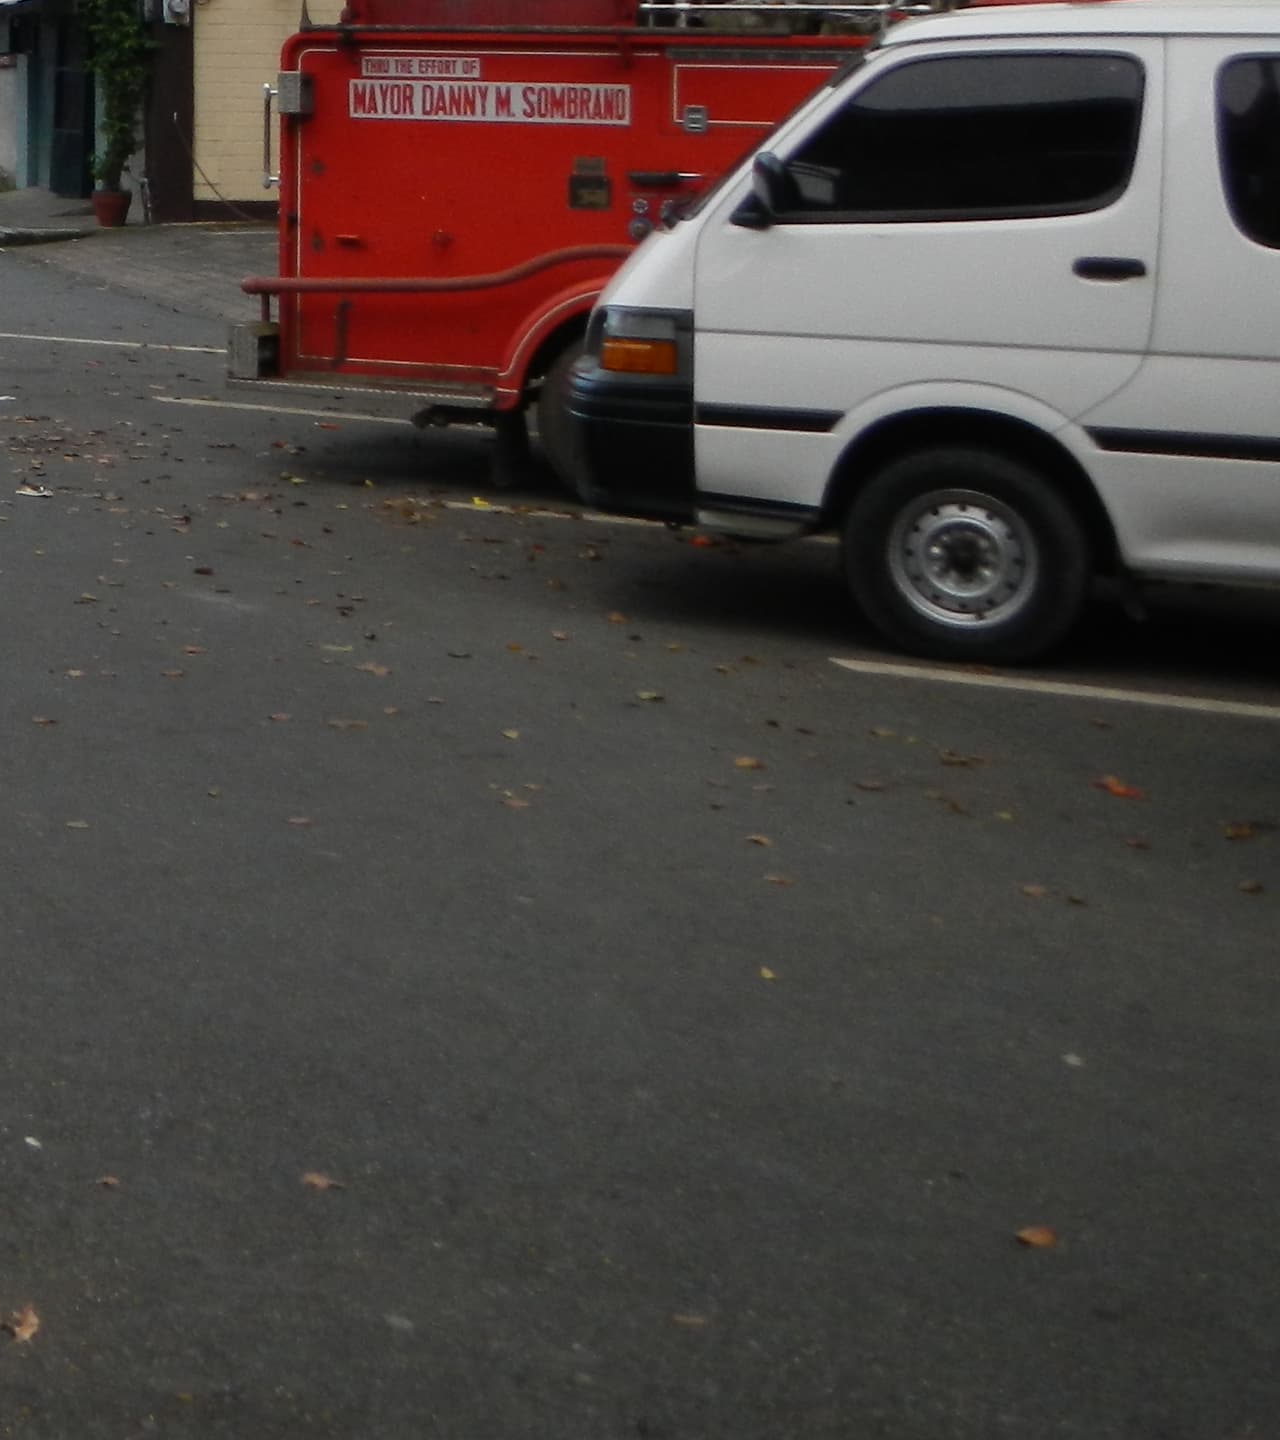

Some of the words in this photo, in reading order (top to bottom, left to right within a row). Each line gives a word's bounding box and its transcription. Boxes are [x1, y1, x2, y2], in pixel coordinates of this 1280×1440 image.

[394, 61, 413, 73] THE
[418, 62, 457, 74] EFFORT
[462, 62, 477, 75] OF
[353, 83, 415, 115] MAYOR
[421, 84, 490, 116] DANNY
[494, 86, 516, 117] M.
[521, 86, 628, 121] SOMBRANO
